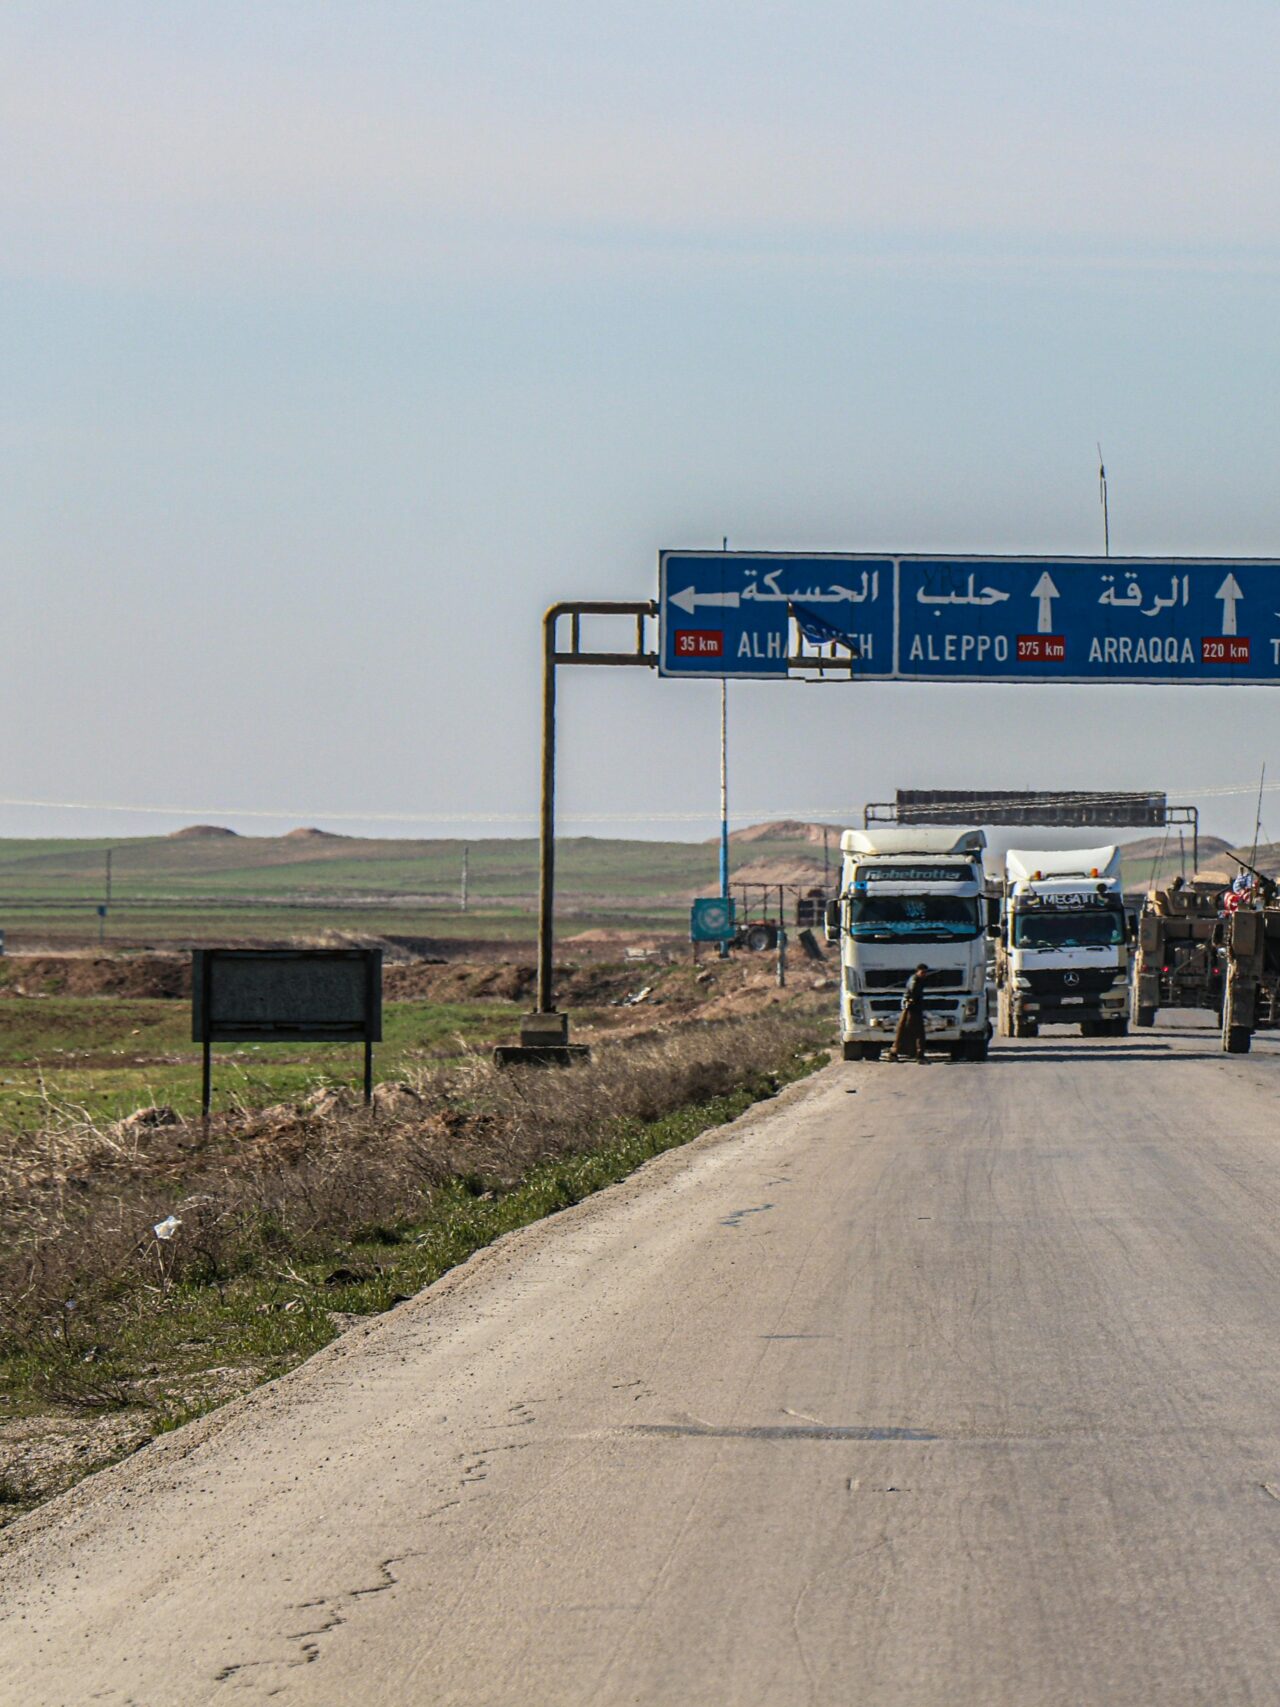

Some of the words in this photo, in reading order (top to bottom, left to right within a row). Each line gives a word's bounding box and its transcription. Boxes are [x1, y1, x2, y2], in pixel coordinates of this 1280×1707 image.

[741, 569, 879, 603] الحسكة
[916, 573, 1011, 617] حلب
[1098, 571, 1189, 617] الرقة
[680, 636, 696, 651] 35
[698, 636, 719, 651] km
[909, 634, 1008, 662] ALEPPO
[1018, 641, 1040, 656] 375
[1045, 641, 1064, 656] km
[1088, 636, 1195, 664] ARRAQQA
[1203, 643, 1225, 658] 220
[1230, 643, 1249, 658] km
